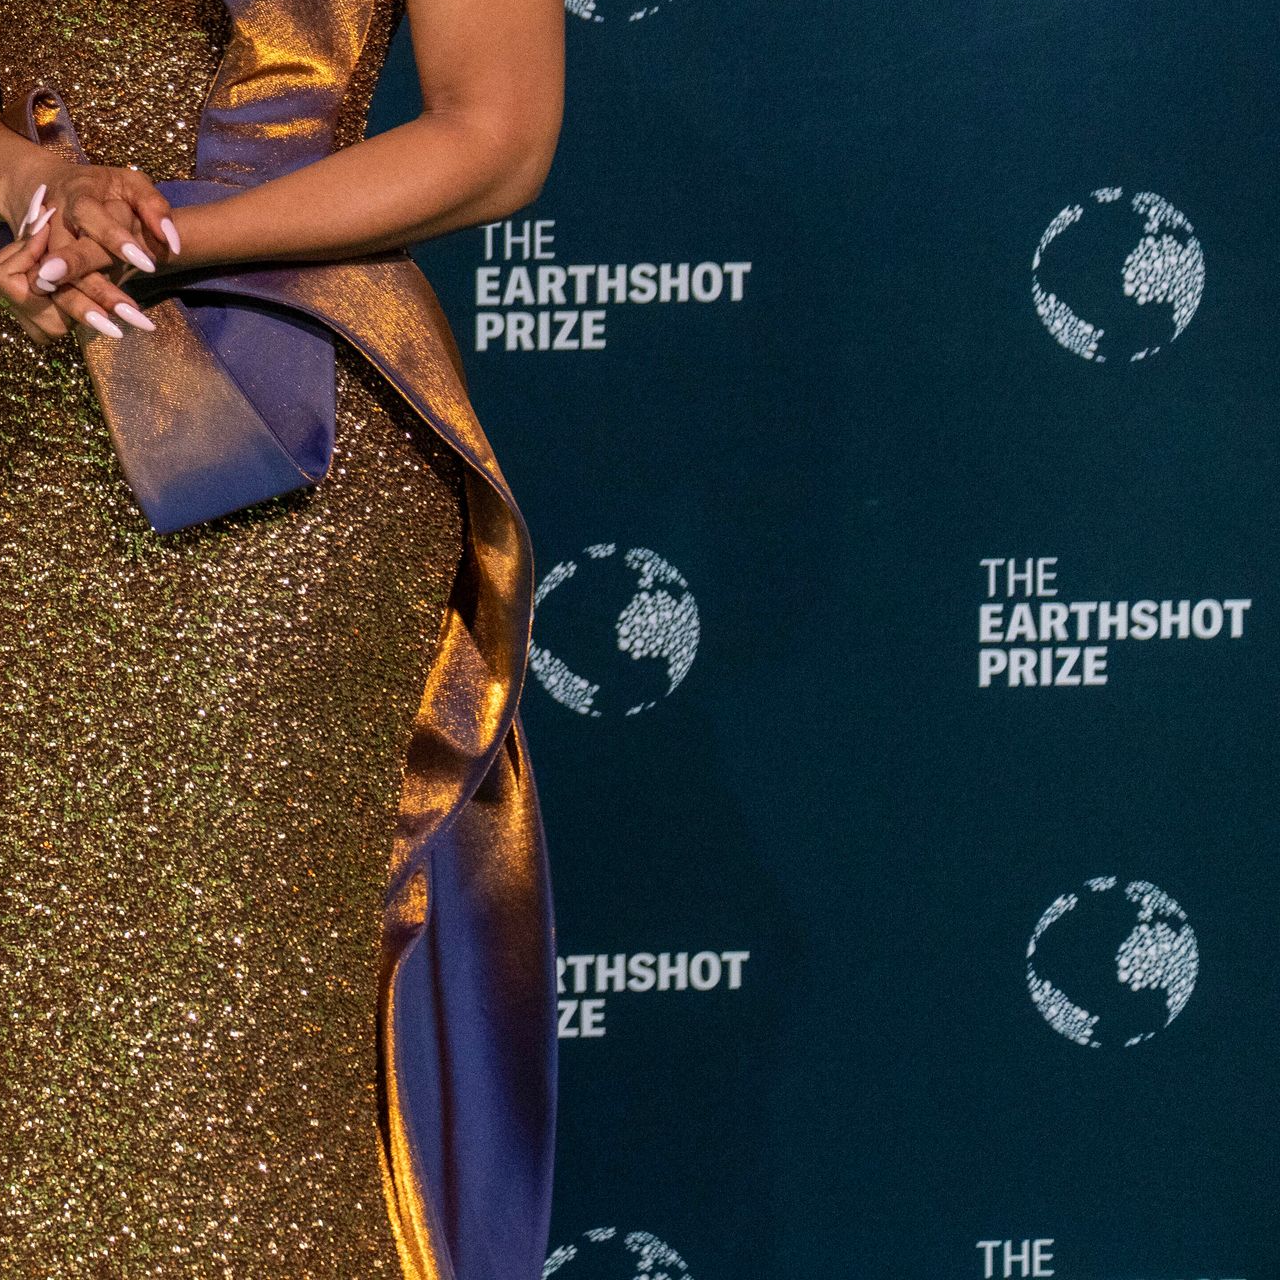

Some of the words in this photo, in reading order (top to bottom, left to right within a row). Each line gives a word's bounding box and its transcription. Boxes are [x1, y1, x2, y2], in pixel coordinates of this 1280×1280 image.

[481, 219, 556, 261] THE
[476, 261, 752, 306] EARTHSHOT
[475, 310, 607, 352] PRIZE
[979, 557, 1058, 598] THE
[979, 598, 1252, 643] EARTHSHOT
[979, 646, 1108, 688] PRIZE
[976, 1238, 1055, 1279] THE
